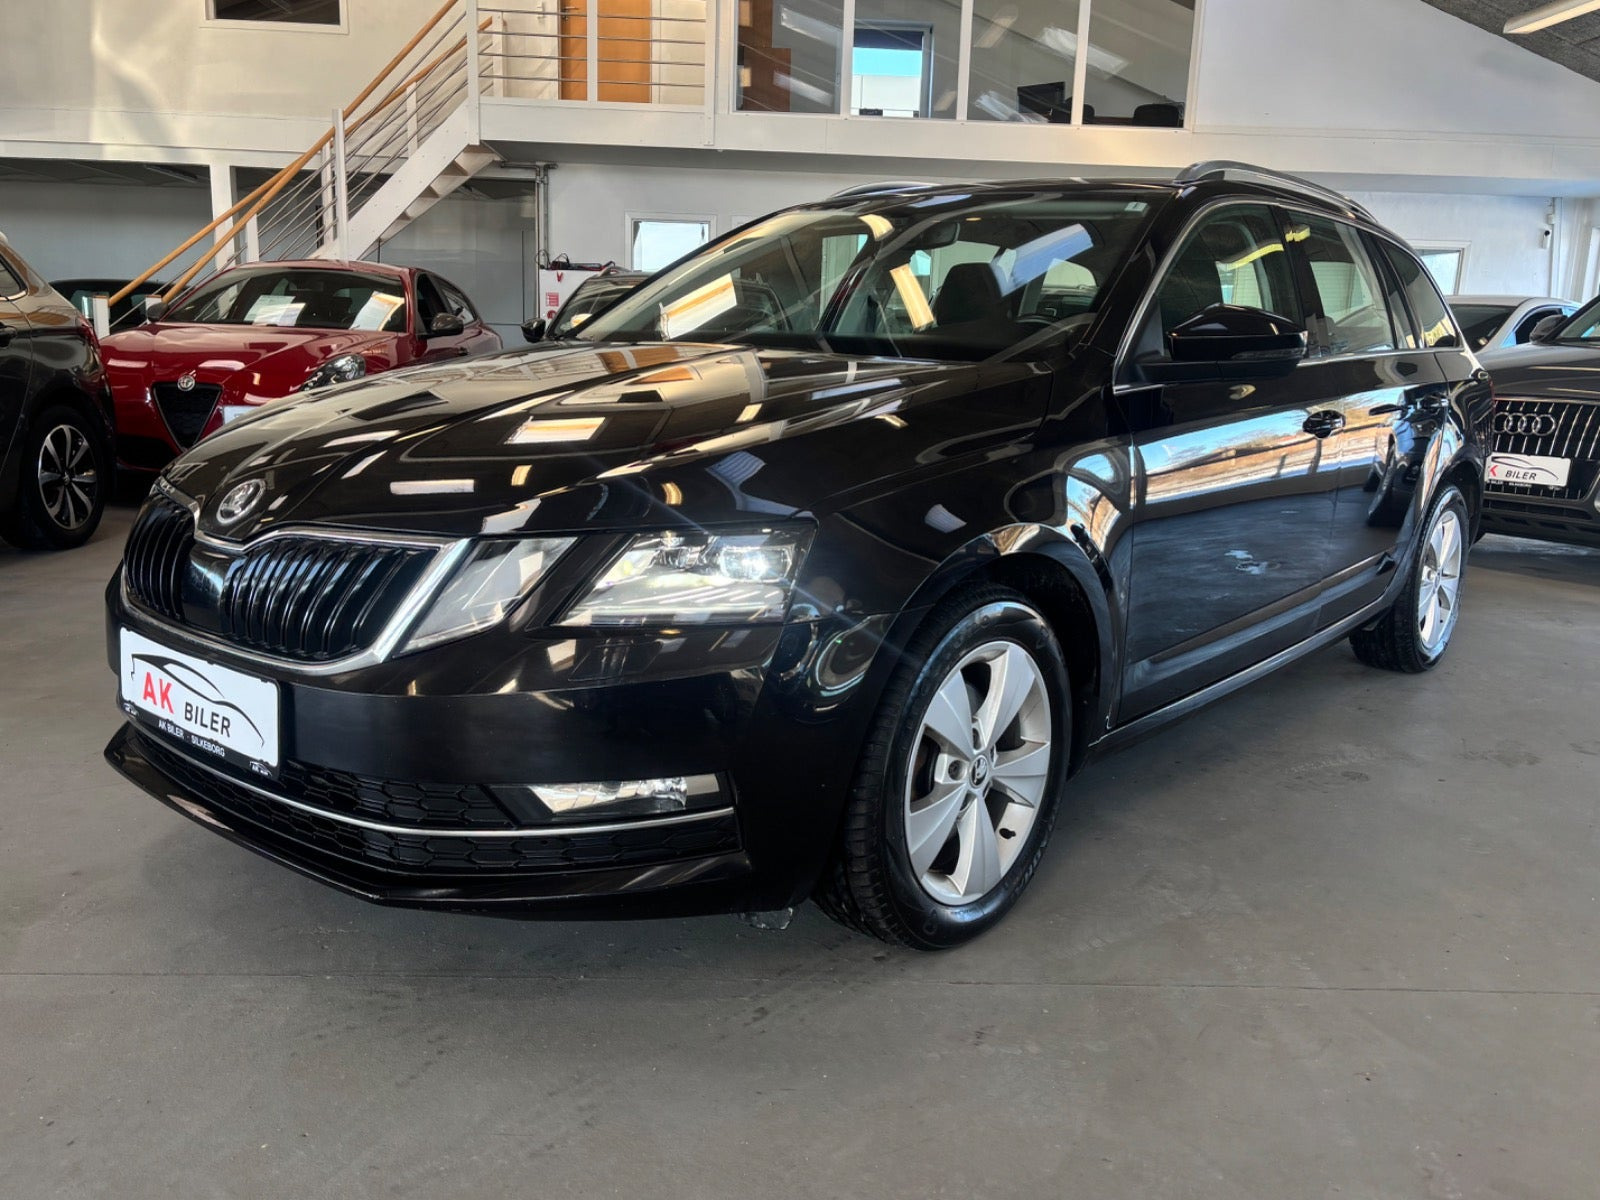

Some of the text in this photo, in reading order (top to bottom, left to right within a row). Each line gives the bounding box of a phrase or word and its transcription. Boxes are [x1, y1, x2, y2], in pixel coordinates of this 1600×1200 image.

[1505, 470, 1537, 480] BILER
[143, 671, 231, 738] AK BILER
[158, 719, 167, 731] AK
[167, 724, 184, 739] BILER
[191, 734, 225, 757] SILKEBORG
